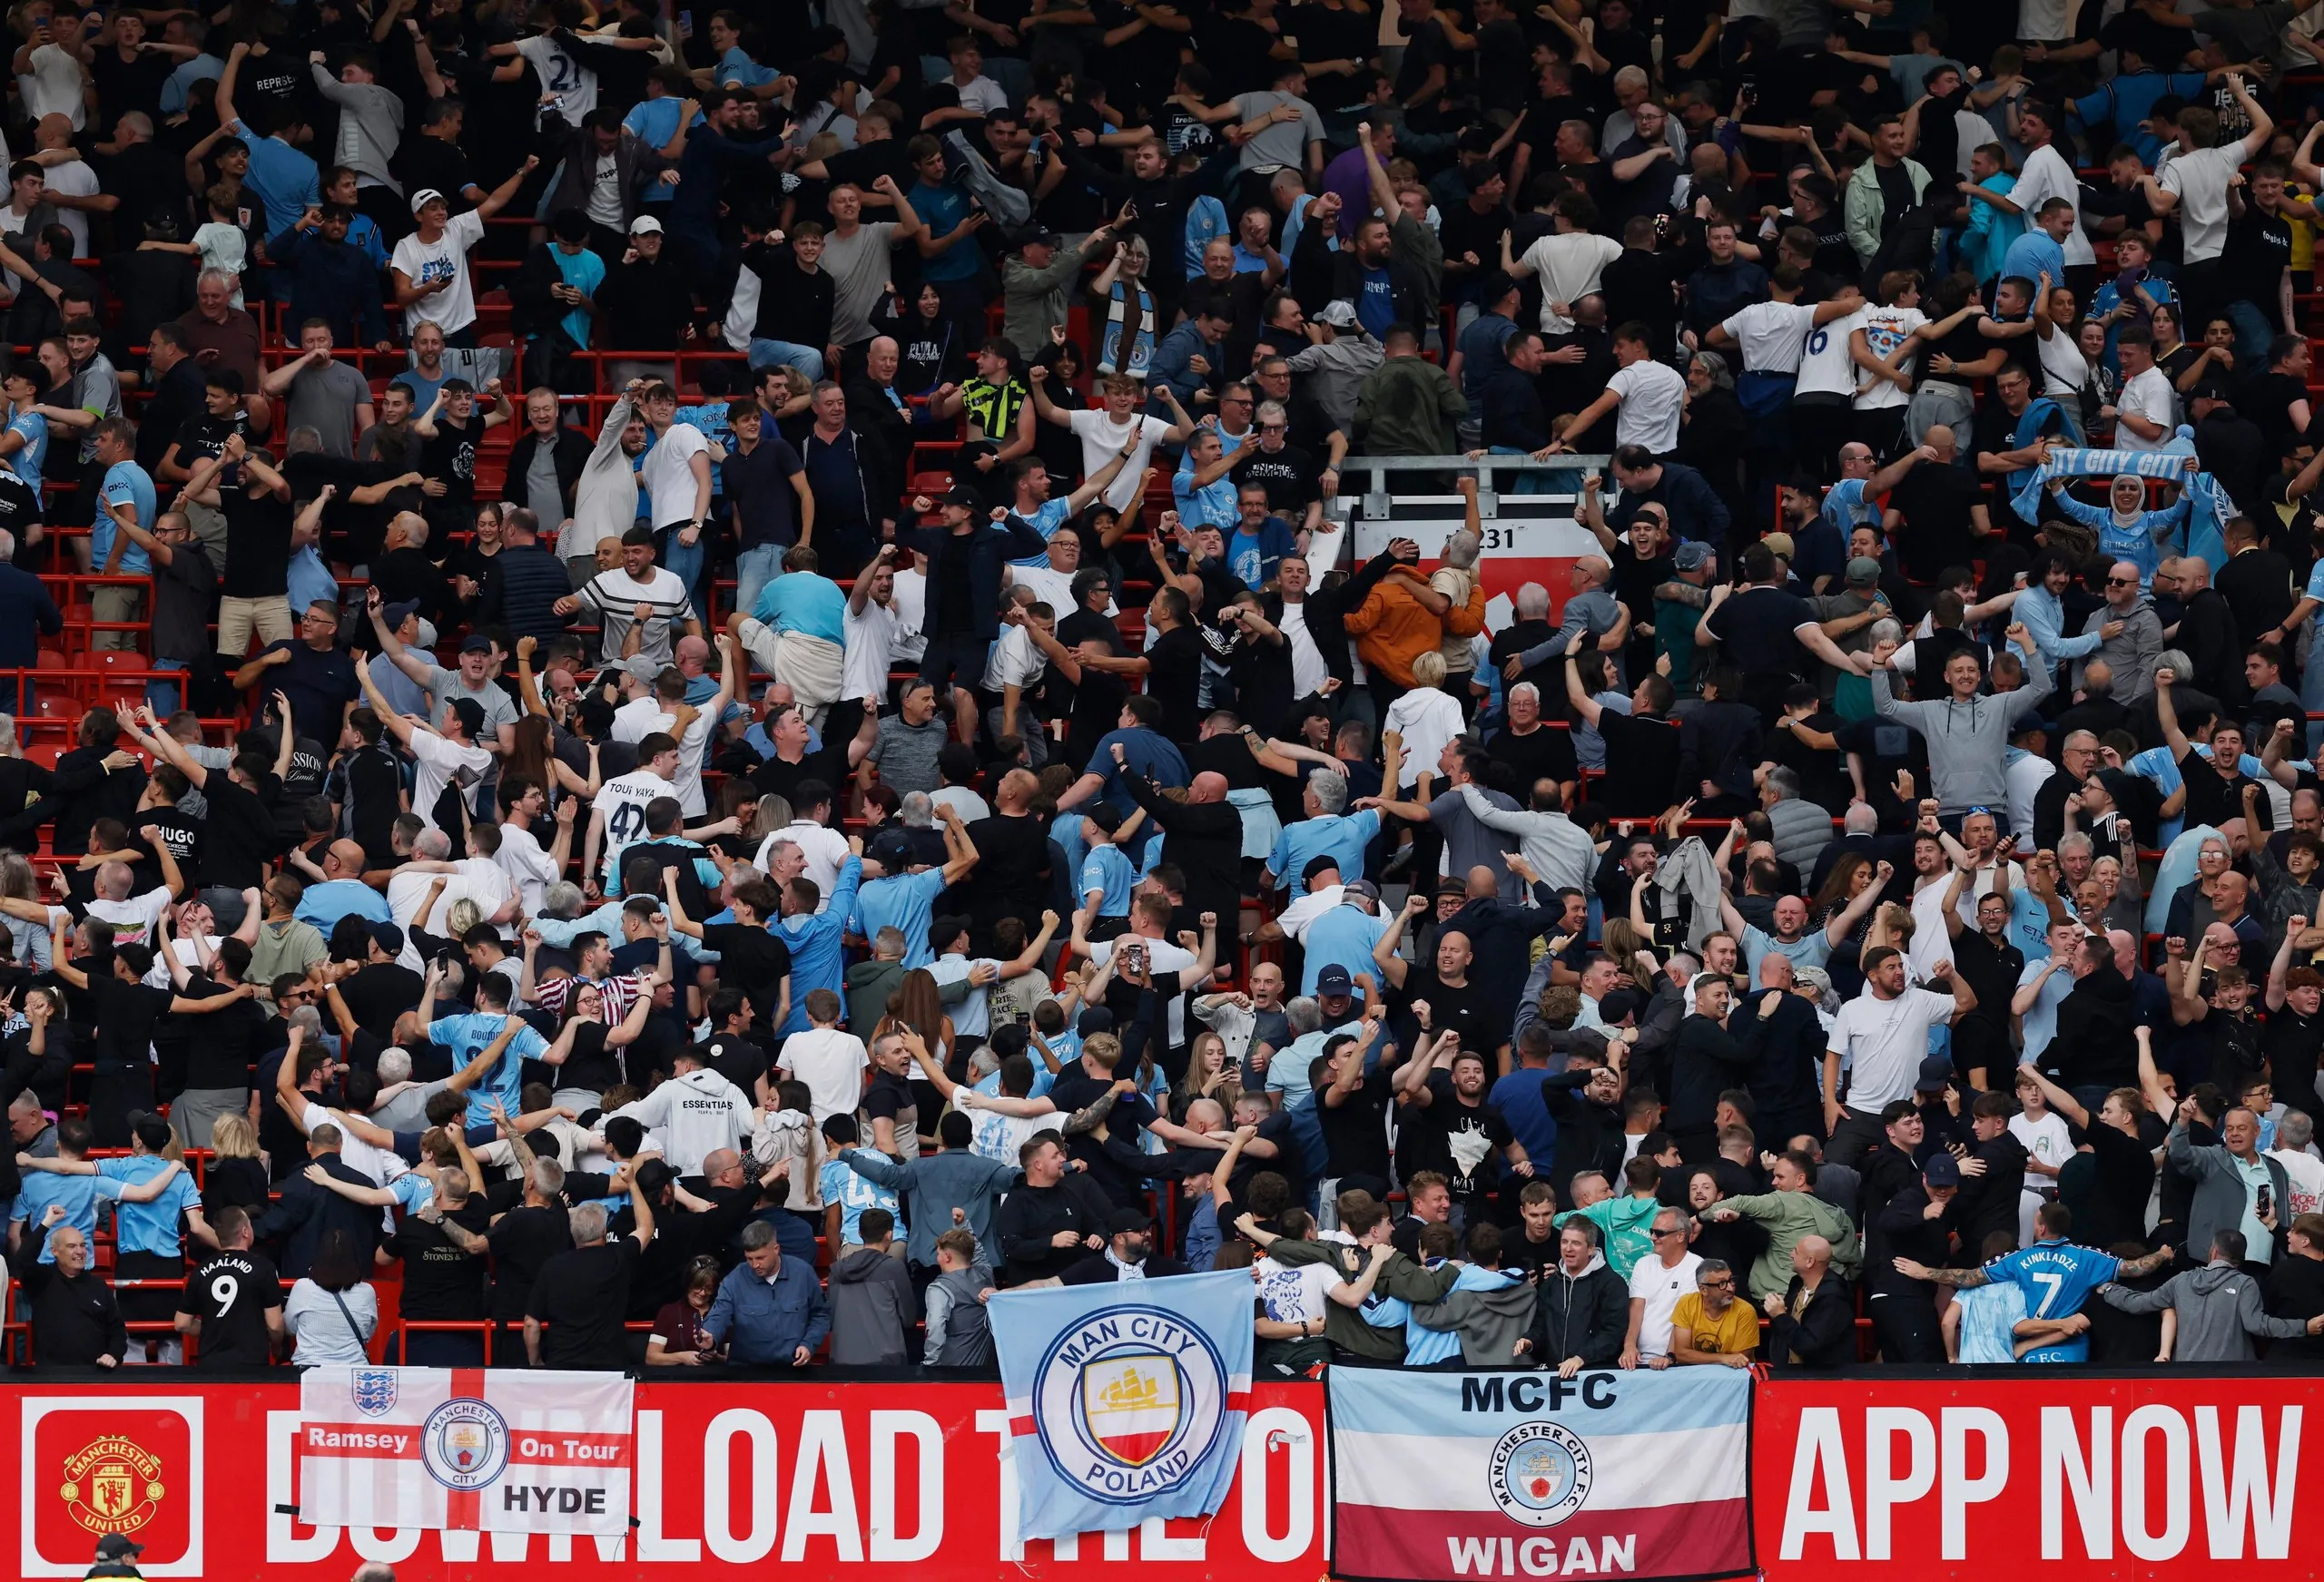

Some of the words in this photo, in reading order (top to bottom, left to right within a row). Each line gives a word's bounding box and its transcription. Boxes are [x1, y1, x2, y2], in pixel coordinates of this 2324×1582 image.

[2085, 449, 2133, 473] CITY
[2137, 452, 2187, 480] CITY
[290, 752, 321, 771] SSION
[635, 788, 655, 799] YAYA
[157, 825, 195, 845] HUGO
[609, 801, 646, 844] 42
[991, 1005, 1010, 1015] FACE
[1452, 1175, 1475, 1191] WAY
[2290, 1192, 2318, 1206] WORL
[2290, 1204, 2310, 1214] CUP
[200, 1257, 252, 1277] HAALAND
[423, 1251, 453, 1262] STONES
[2020, 1251, 2078, 1272] KINKLADZE
[211, 1274, 239, 1318] 9
[2033, 1272, 2063, 1320] 7
[1059, 1319, 1119, 1369] MAN
[1131, 1317, 1196, 1355] CITY
[1462, 1372, 1618, 1413] MCFC
[309, 1428, 409, 1454] Ramsey
[431, 1405, 501, 1454] MANCHESTER
[72, 1442, 153, 1479] MANCHESTER
[520, 1438, 554, 1460] On
[562, 1440, 620, 1460] Tour
[1566, 1440, 1589, 1477] CITY
[452, 1474, 478, 1485] CITY
[1085, 1449, 1188, 1493] POLAND
[1493, 1426, 1563, 1506] MANCHESTER
[266, 1408, 945, 1564] DLOAD
[1778, 1406, 2010, 1561] APP
[2040, 1403, 2304, 1562] NOW
[1562, 1482, 1587, 1509] F.C.
[504, 1485, 606, 1515] HYDE
[84, 1514, 142, 1533] UNITED
[1446, 1533, 1637, 1577] WIGAN
